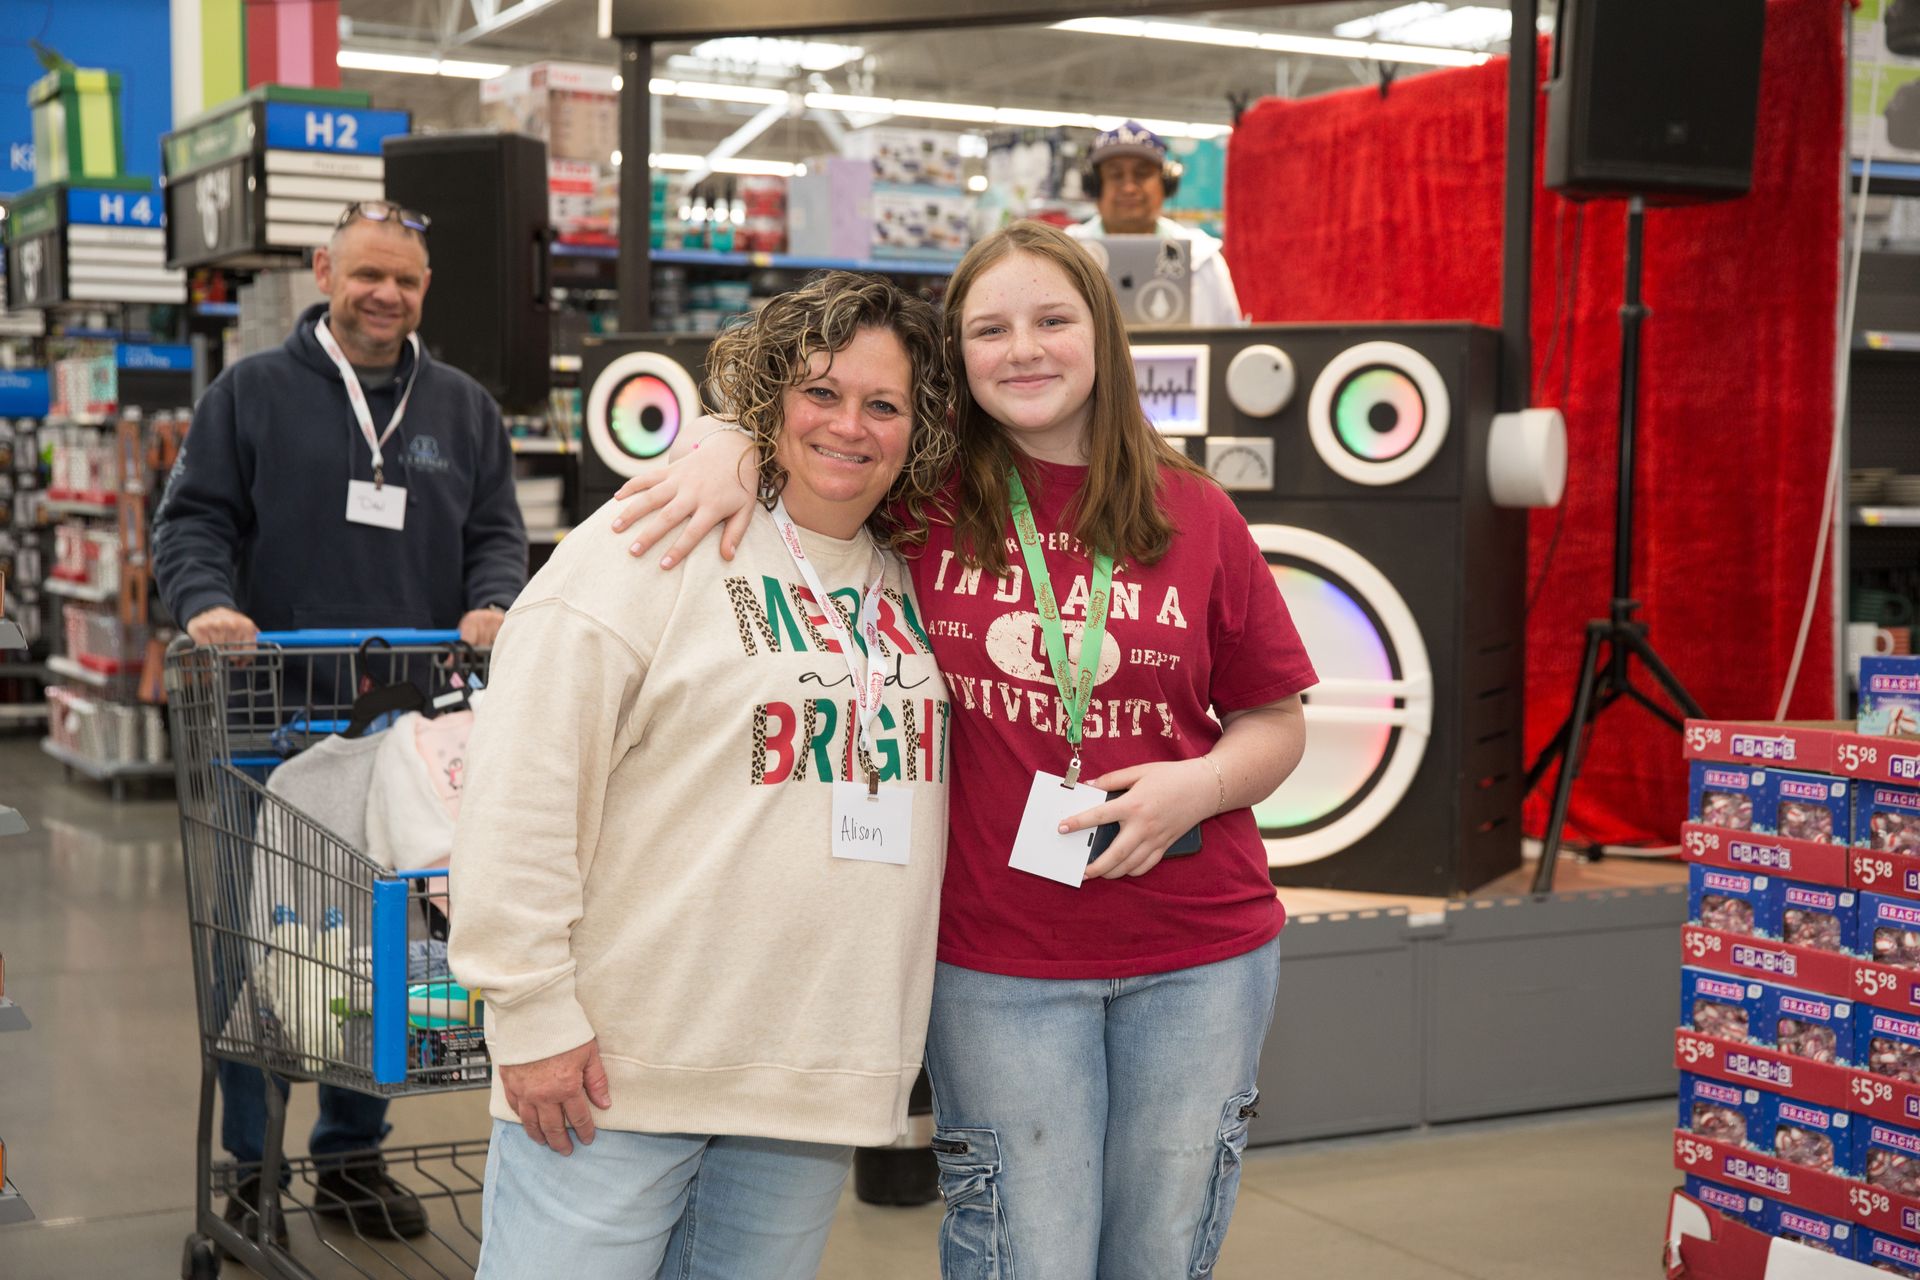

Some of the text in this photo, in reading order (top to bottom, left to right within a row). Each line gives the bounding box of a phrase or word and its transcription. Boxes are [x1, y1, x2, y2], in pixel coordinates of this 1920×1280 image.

[305, 111, 358, 149] H2
[934, 550, 1187, 629] INDANA
[1130, 648, 1181, 670] DEPT
[943, 671, 1175, 740] NIVERSITY
[840, 815, 883, 846] Alison
